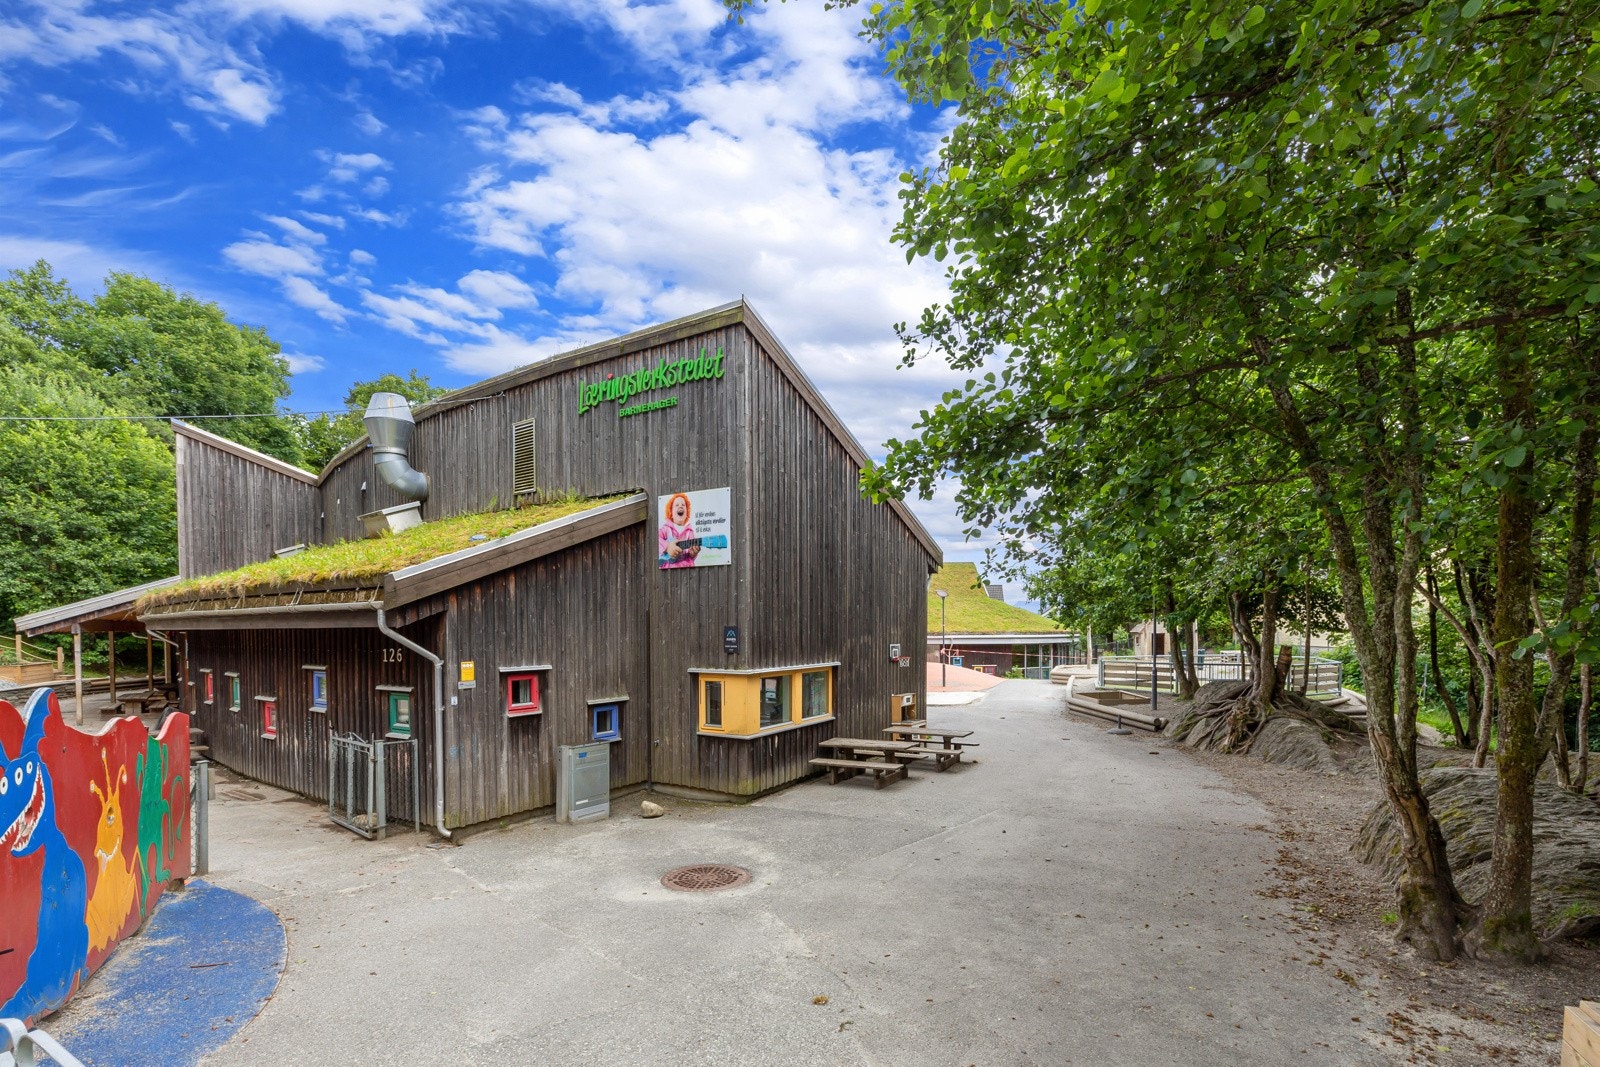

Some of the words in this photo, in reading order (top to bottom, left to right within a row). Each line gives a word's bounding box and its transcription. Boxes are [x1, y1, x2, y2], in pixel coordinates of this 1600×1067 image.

[578, 346, 725, 415] Læringsverkstedet
[619, 397, 678, 417] BARNEHAGER
[382, 648, 403, 662] 126
